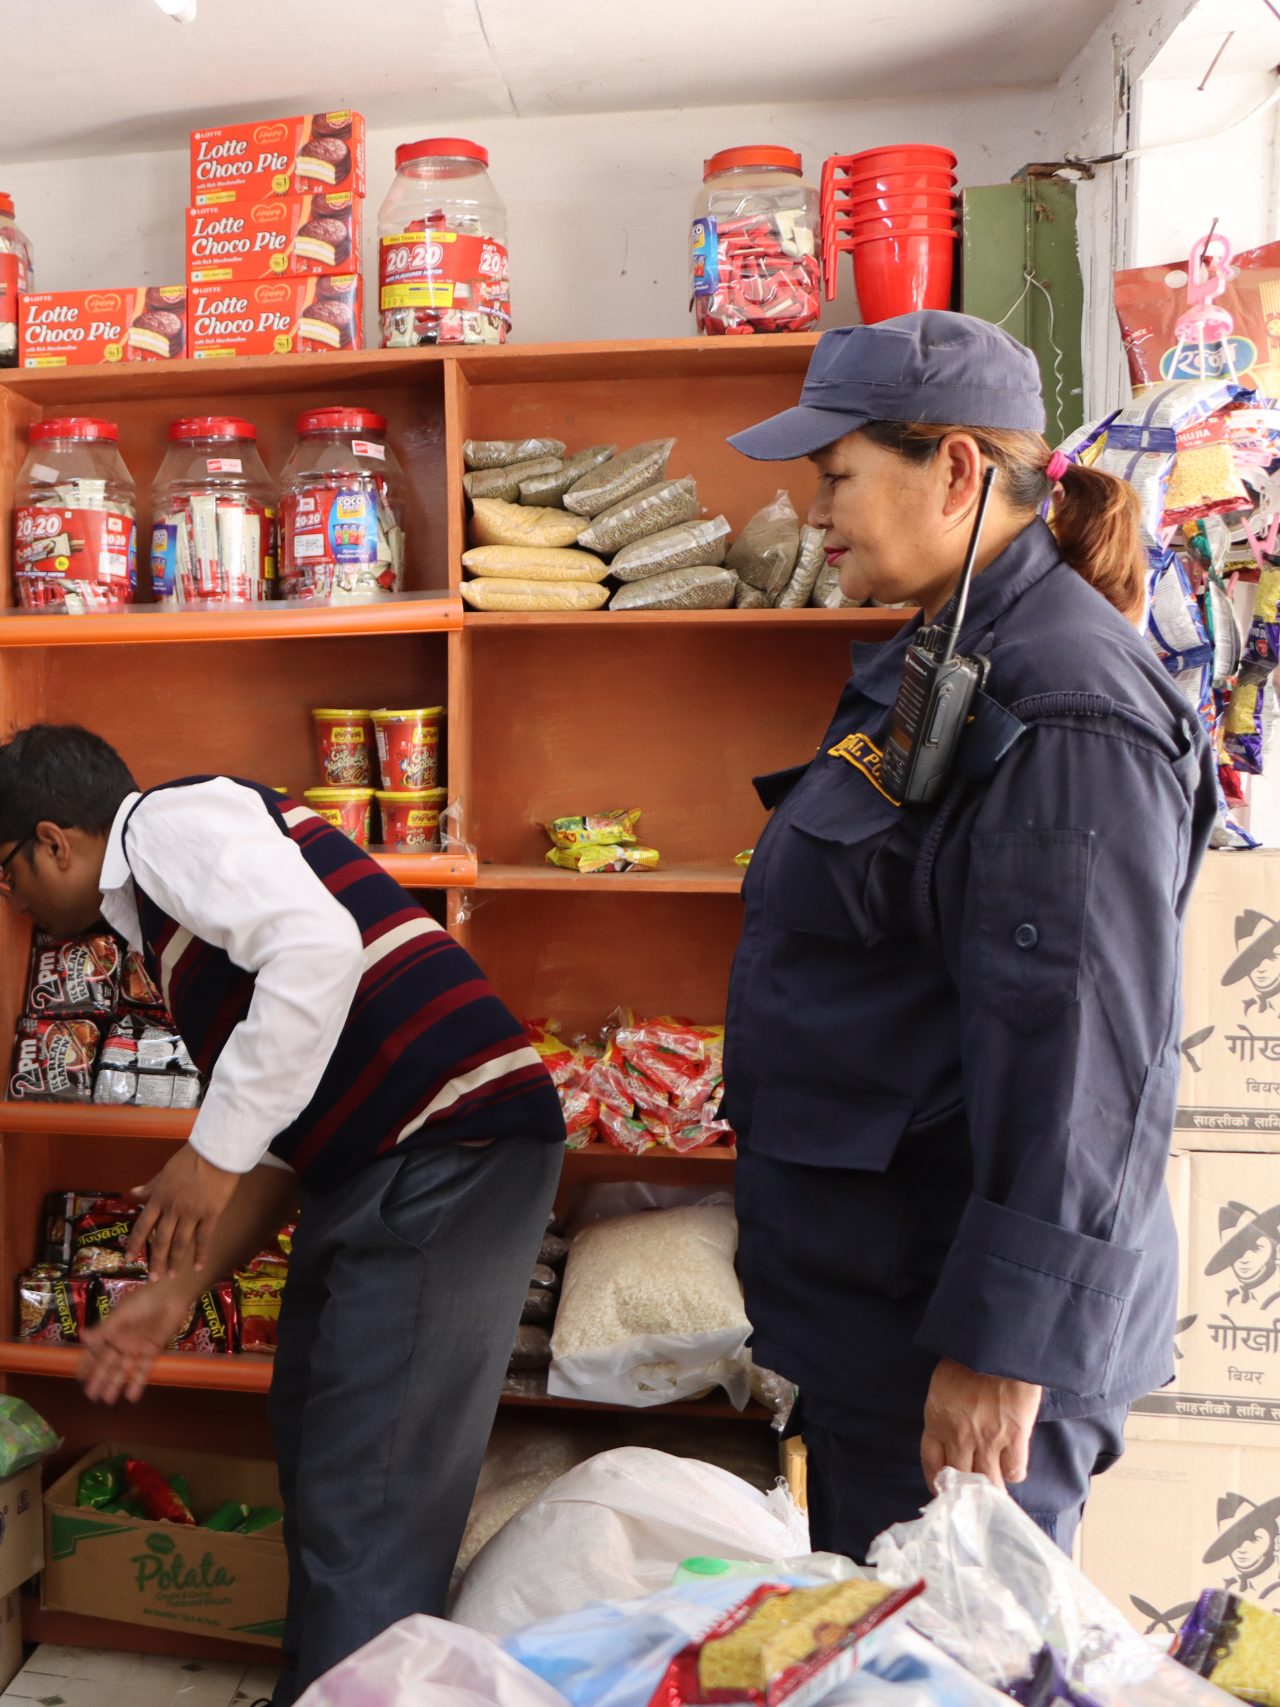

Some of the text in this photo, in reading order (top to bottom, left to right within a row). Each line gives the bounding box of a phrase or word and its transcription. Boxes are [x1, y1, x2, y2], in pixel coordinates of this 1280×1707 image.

[197, 140, 247, 160] Lotte
[196, 153, 288, 180] Choco Pie
[192, 216, 245, 237] Lotte
[192, 232, 287, 256] Choco Pie
[387, 245, 443, 272] 20-20
[26, 306, 78, 324] Lotte
[196, 297, 248, 316] Lotte
[25, 322, 121, 344] Choco Pie
[194, 312, 291, 336] Choco Pie
[1175, 429, 1210, 443] HUJIA
[16, 514, 61, 537] 20-20
[407, 834, 425, 846] Cup
[66, 946, 81, 1003] KOREAN
[76, 949, 90, 999] RAMEN
[47, 1035, 64, 1092] KOREAN
[59, 1038, 72, 1087] RAMEN
[1175, 1401, 1266, 1418] साहसीको लागि
[131, 1553, 237, 1592] Potata
